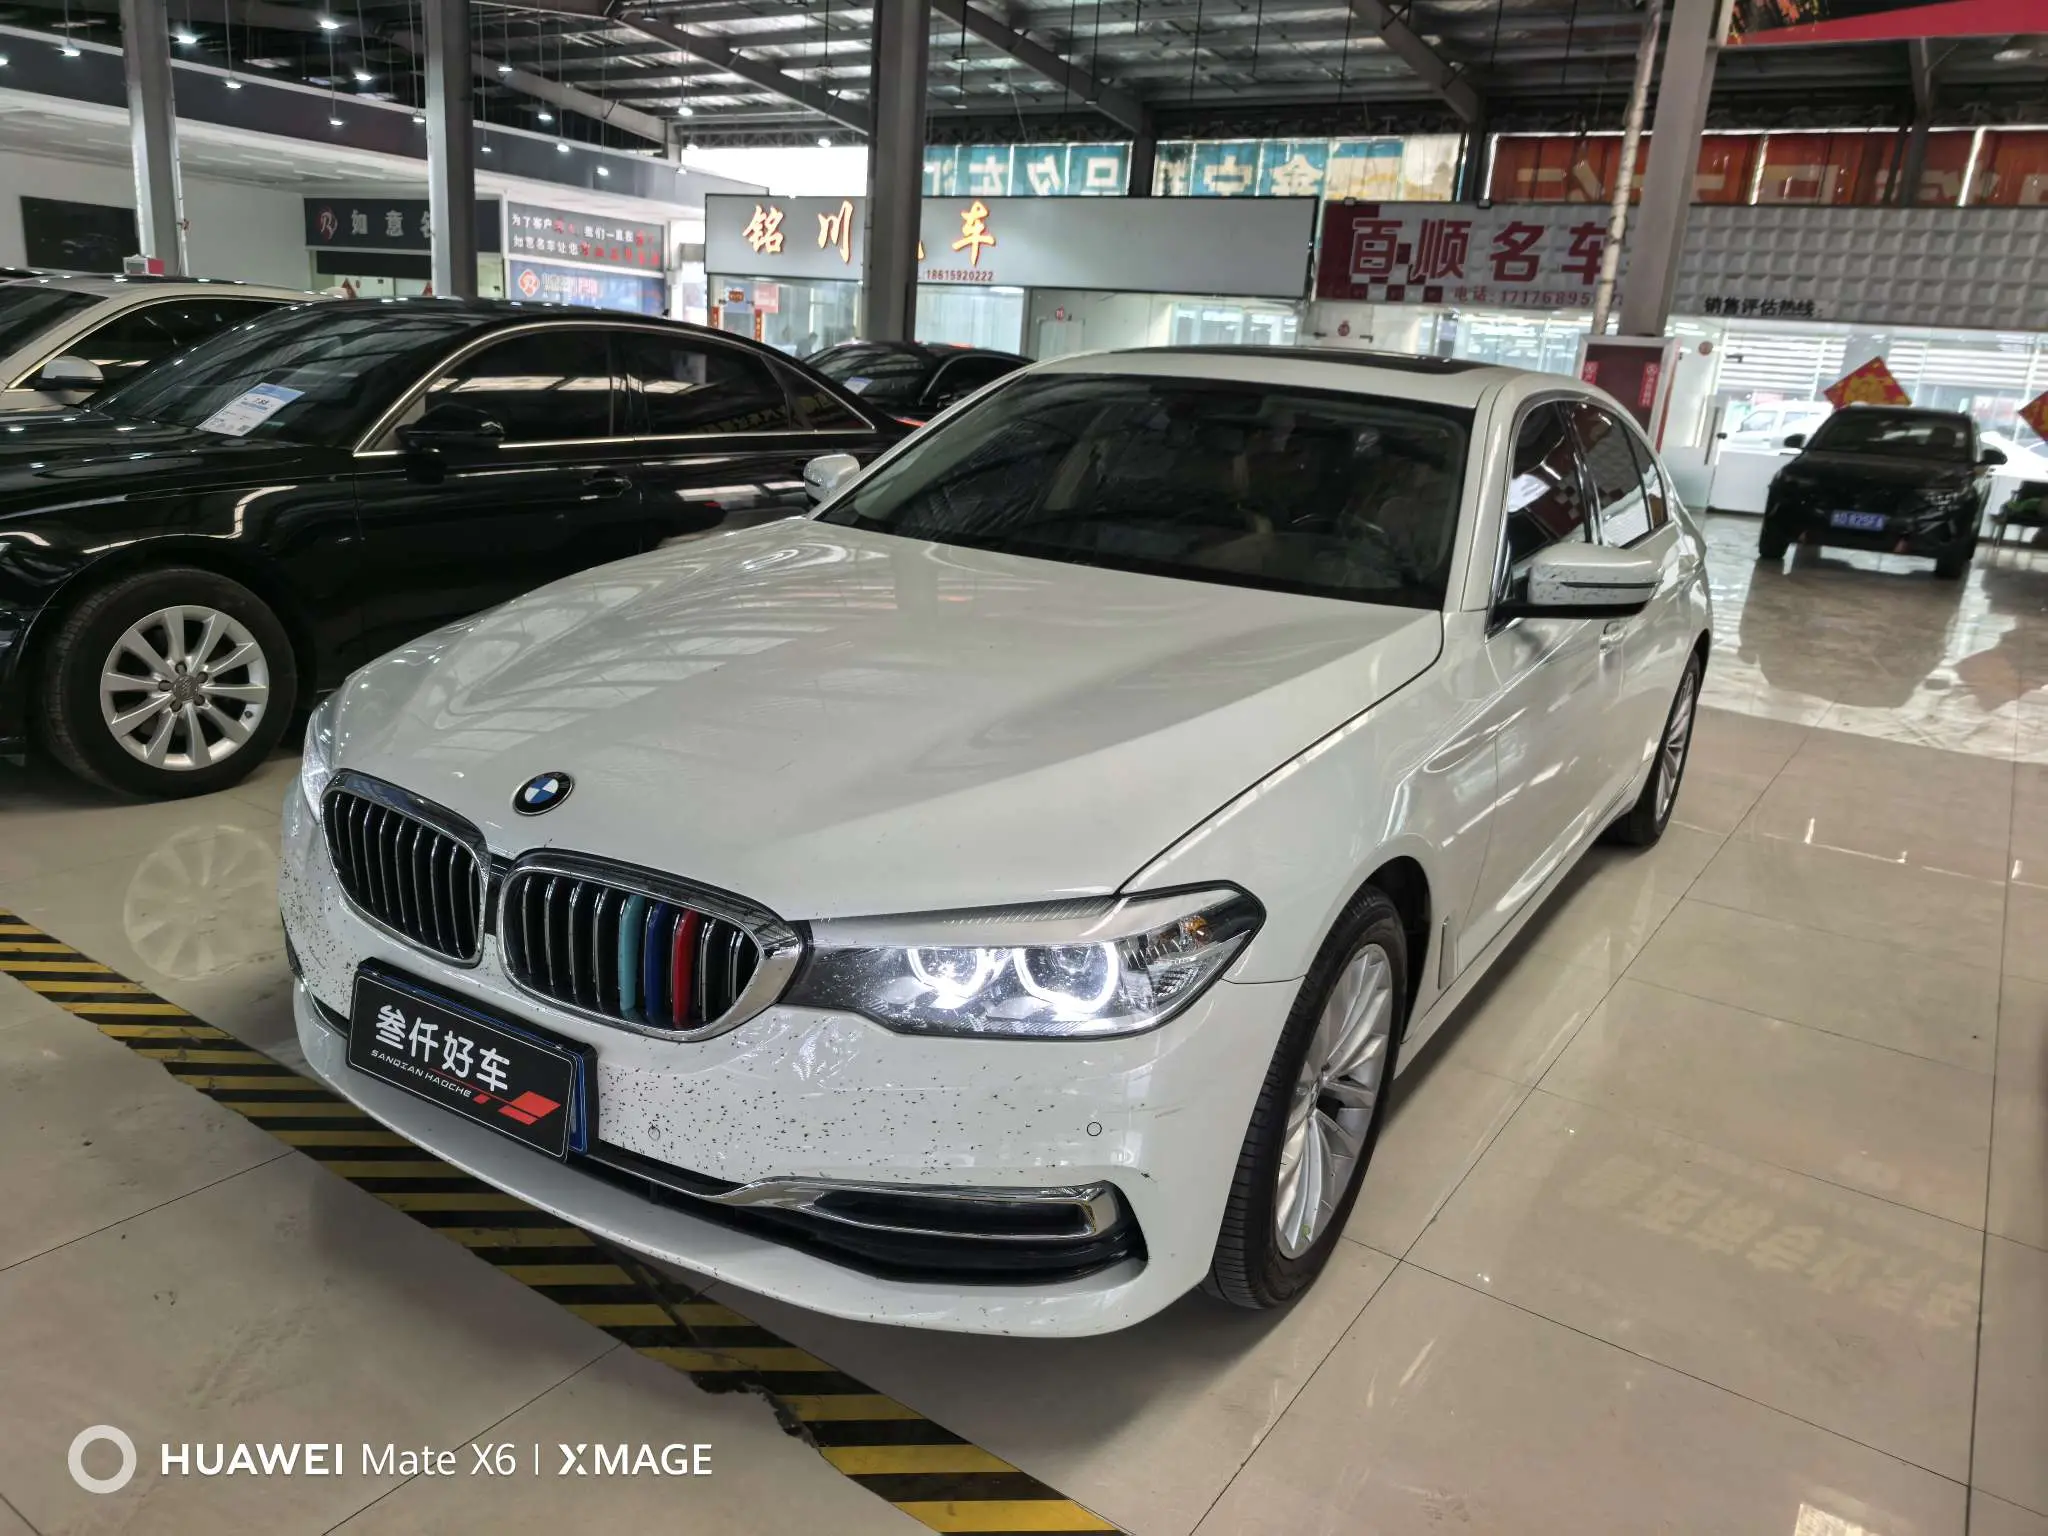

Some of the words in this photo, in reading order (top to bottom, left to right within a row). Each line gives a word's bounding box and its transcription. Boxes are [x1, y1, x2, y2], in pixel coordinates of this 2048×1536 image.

[742, 199, 996, 267] 铭川车
[370, 1049, 424, 1078] SANQIAN
[424, 1071, 473, 1098] HAOCHE
[375, 1004, 511, 1092] 叁仟好车
